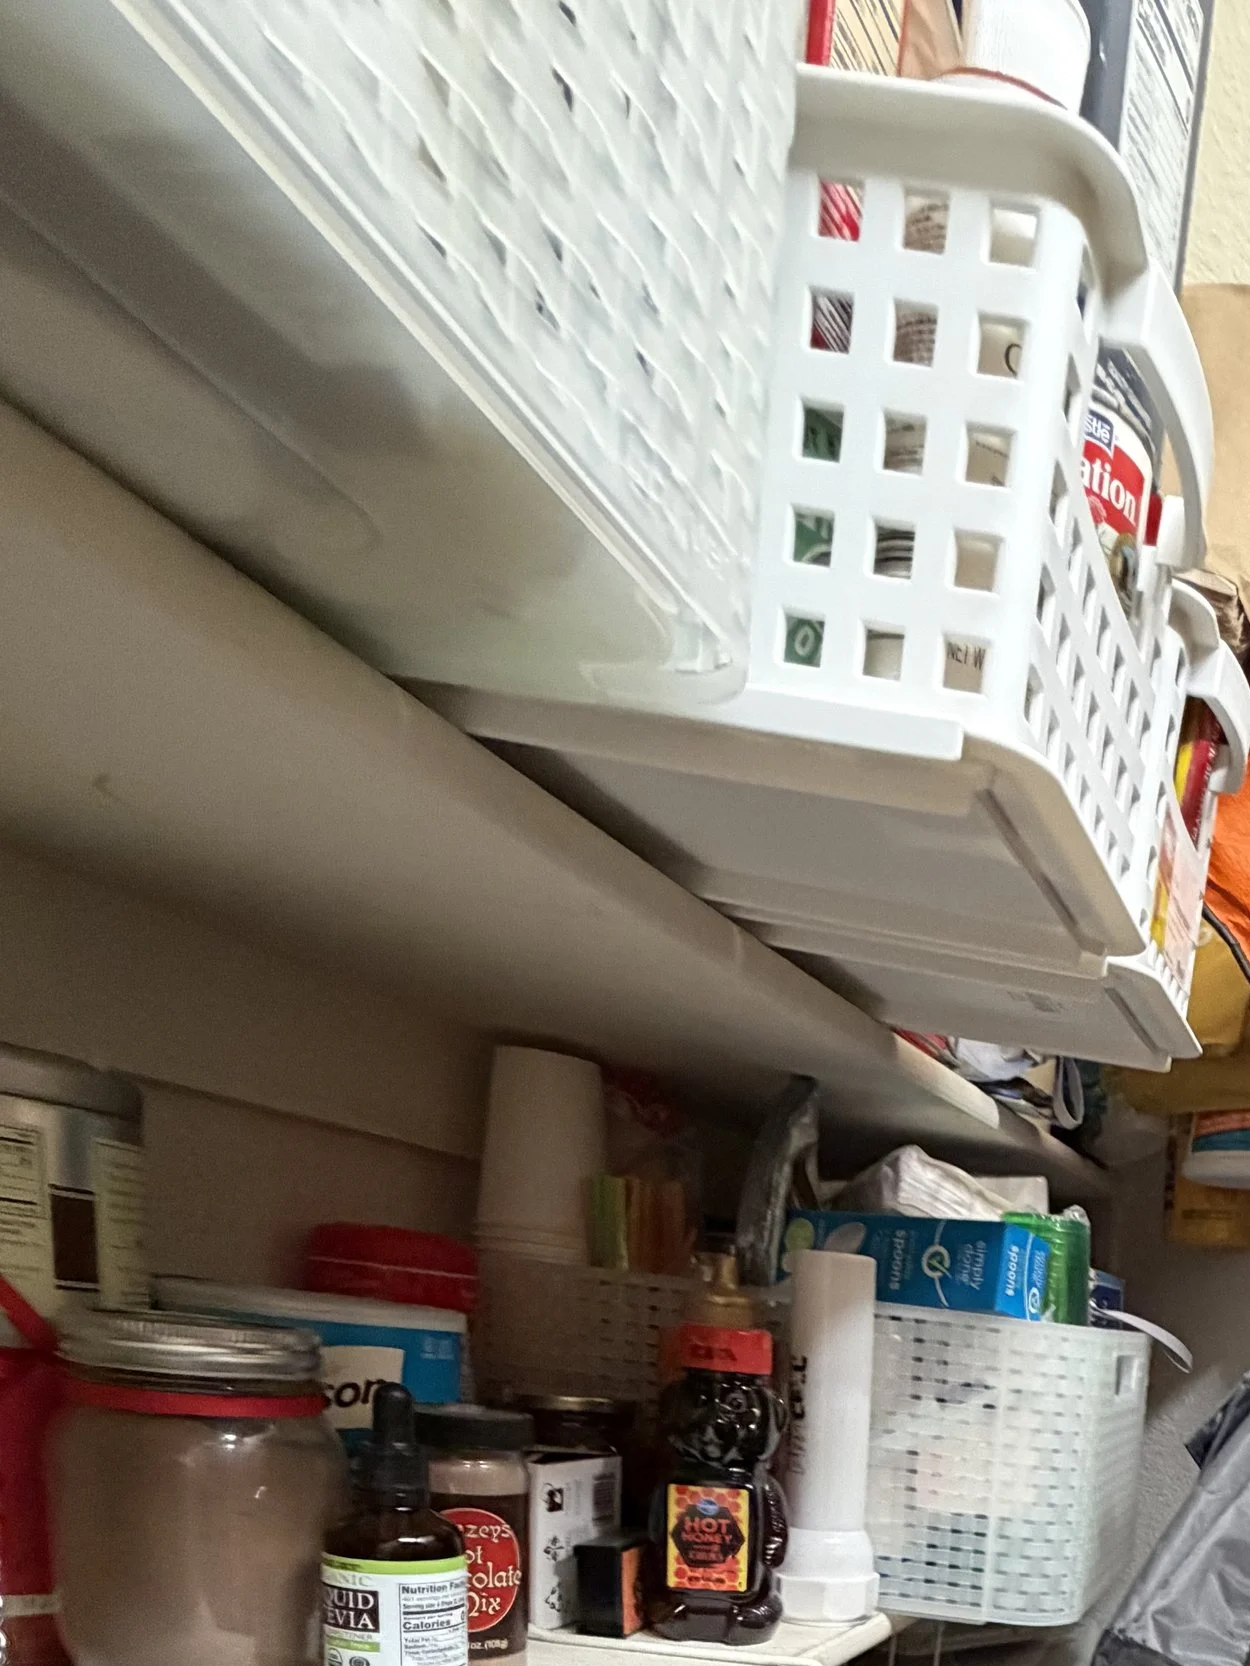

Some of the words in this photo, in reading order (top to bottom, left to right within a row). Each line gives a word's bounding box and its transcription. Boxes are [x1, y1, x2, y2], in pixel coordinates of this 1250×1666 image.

[889, 1229, 907, 1291] spoons
[970, 1240, 989, 1291] simply
[1004, 1245, 1020, 1297] spoons
[683, 1516, 731, 1535] HOT
[465, 1546, 484, 1565] ot
[401, 1582, 448, 1595] Nutrition
[326, 1607, 376, 1630] EVIA
[402, 1619, 452, 1631] Calories
